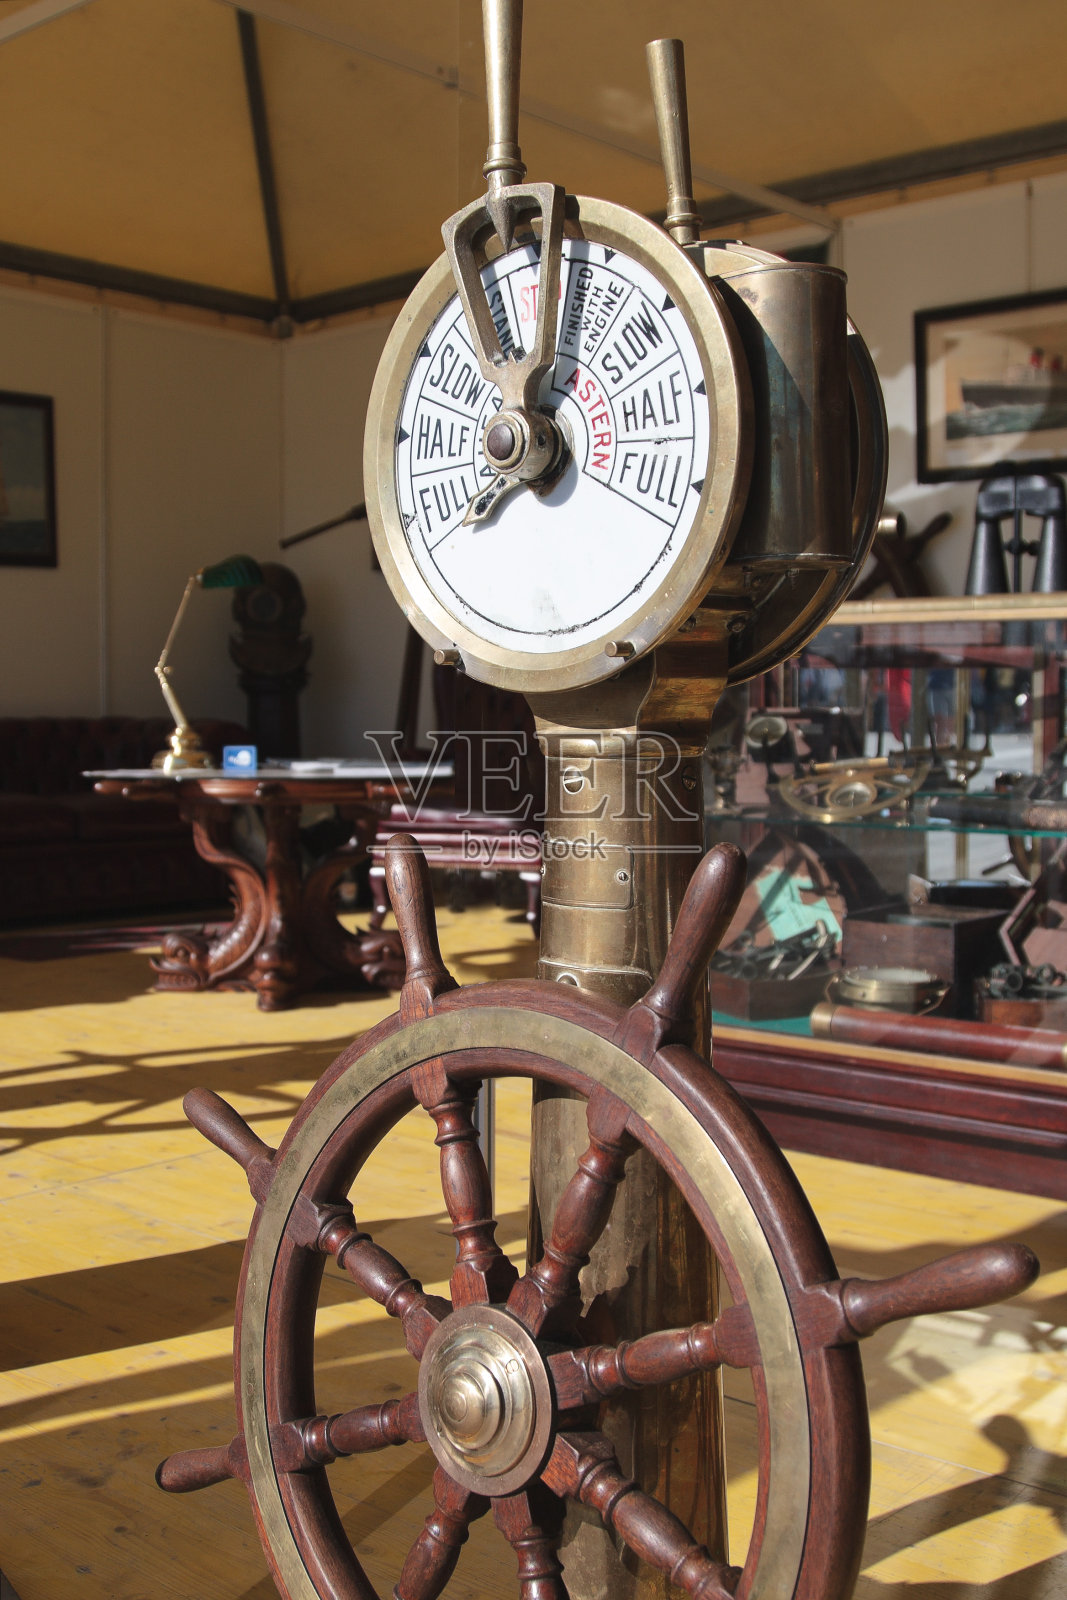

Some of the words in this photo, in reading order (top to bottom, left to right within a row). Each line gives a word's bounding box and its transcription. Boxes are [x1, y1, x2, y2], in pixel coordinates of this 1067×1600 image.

[564, 266, 594, 346] FINISHED
[581, 286, 604, 332] WITH
[584, 281, 625, 353] ENGINE
[601, 300, 664, 385] SLOW
[430, 343, 486, 409] SLOW
[622, 370, 682, 432] HALF
[416, 413, 471, 461] HALF
[564, 368, 613, 471] ASTERN
[419, 475, 473, 531] FULL
[619, 452, 683, 509] FULL
